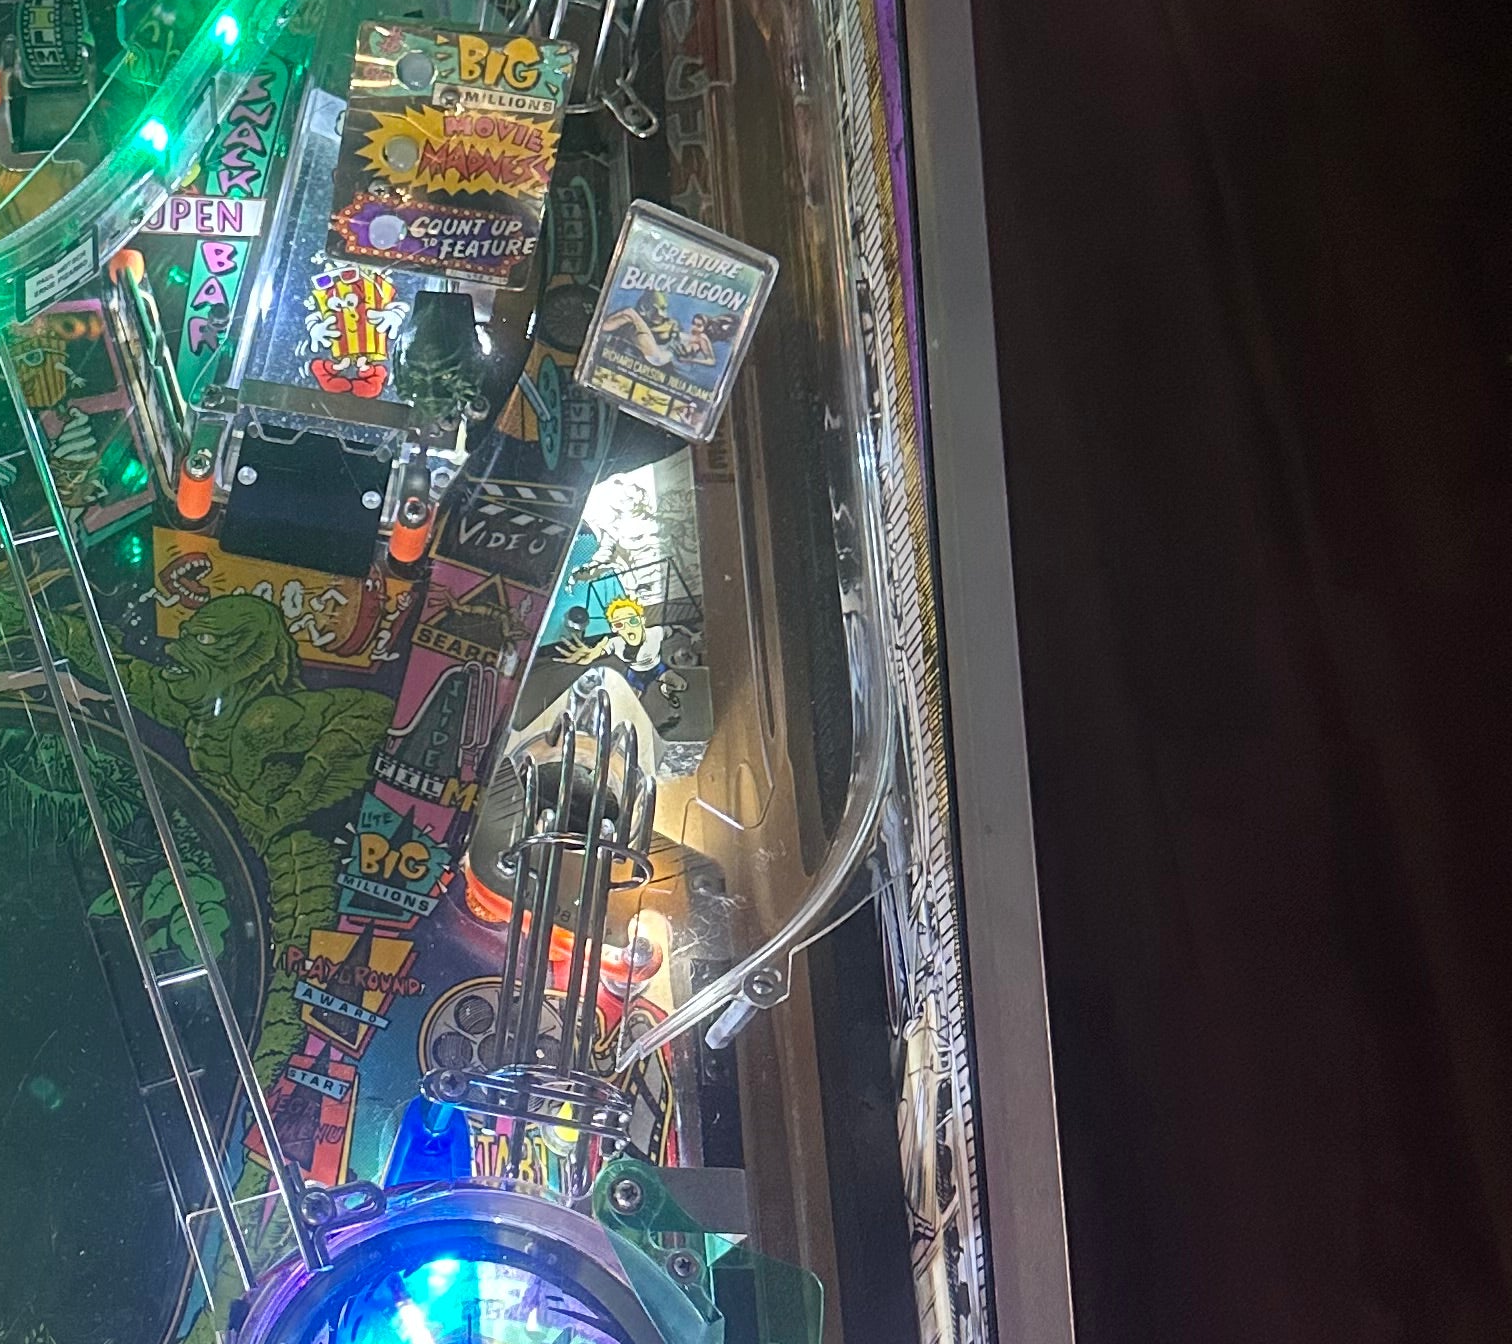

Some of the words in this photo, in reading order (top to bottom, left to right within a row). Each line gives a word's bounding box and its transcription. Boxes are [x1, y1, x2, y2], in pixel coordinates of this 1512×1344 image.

[458, 33, 541, 90] BIG
[464, 89, 554, 115] MILLIONS
[442, 114, 544, 153] MOVIE
[416, 140, 551, 185] MADNESS
[408, 216, 486, 238] COUNT
[491, 219, 523, 237] UP
[422, 236, 438, 248] TO
[438, 236, 537, 261] FEATURE
[651, 238, 745, 280] CREATURE
[620, 266, 678, 293] BLACK
[676, 274, 747, 312] LAGOON
[602, 347, 634, 370] RICHARD
[633, 359, 666, 384] CARLSON
[458, 516, 548, 555] VIDEO
[361, 810, 393, 829] LITE
[358, 832, 432, 882] BIG
[341, 875, 430, 913] MILLIONS
[301, 987, 379, 1025] AWARD
[288, 1068, 349, 1096] START
